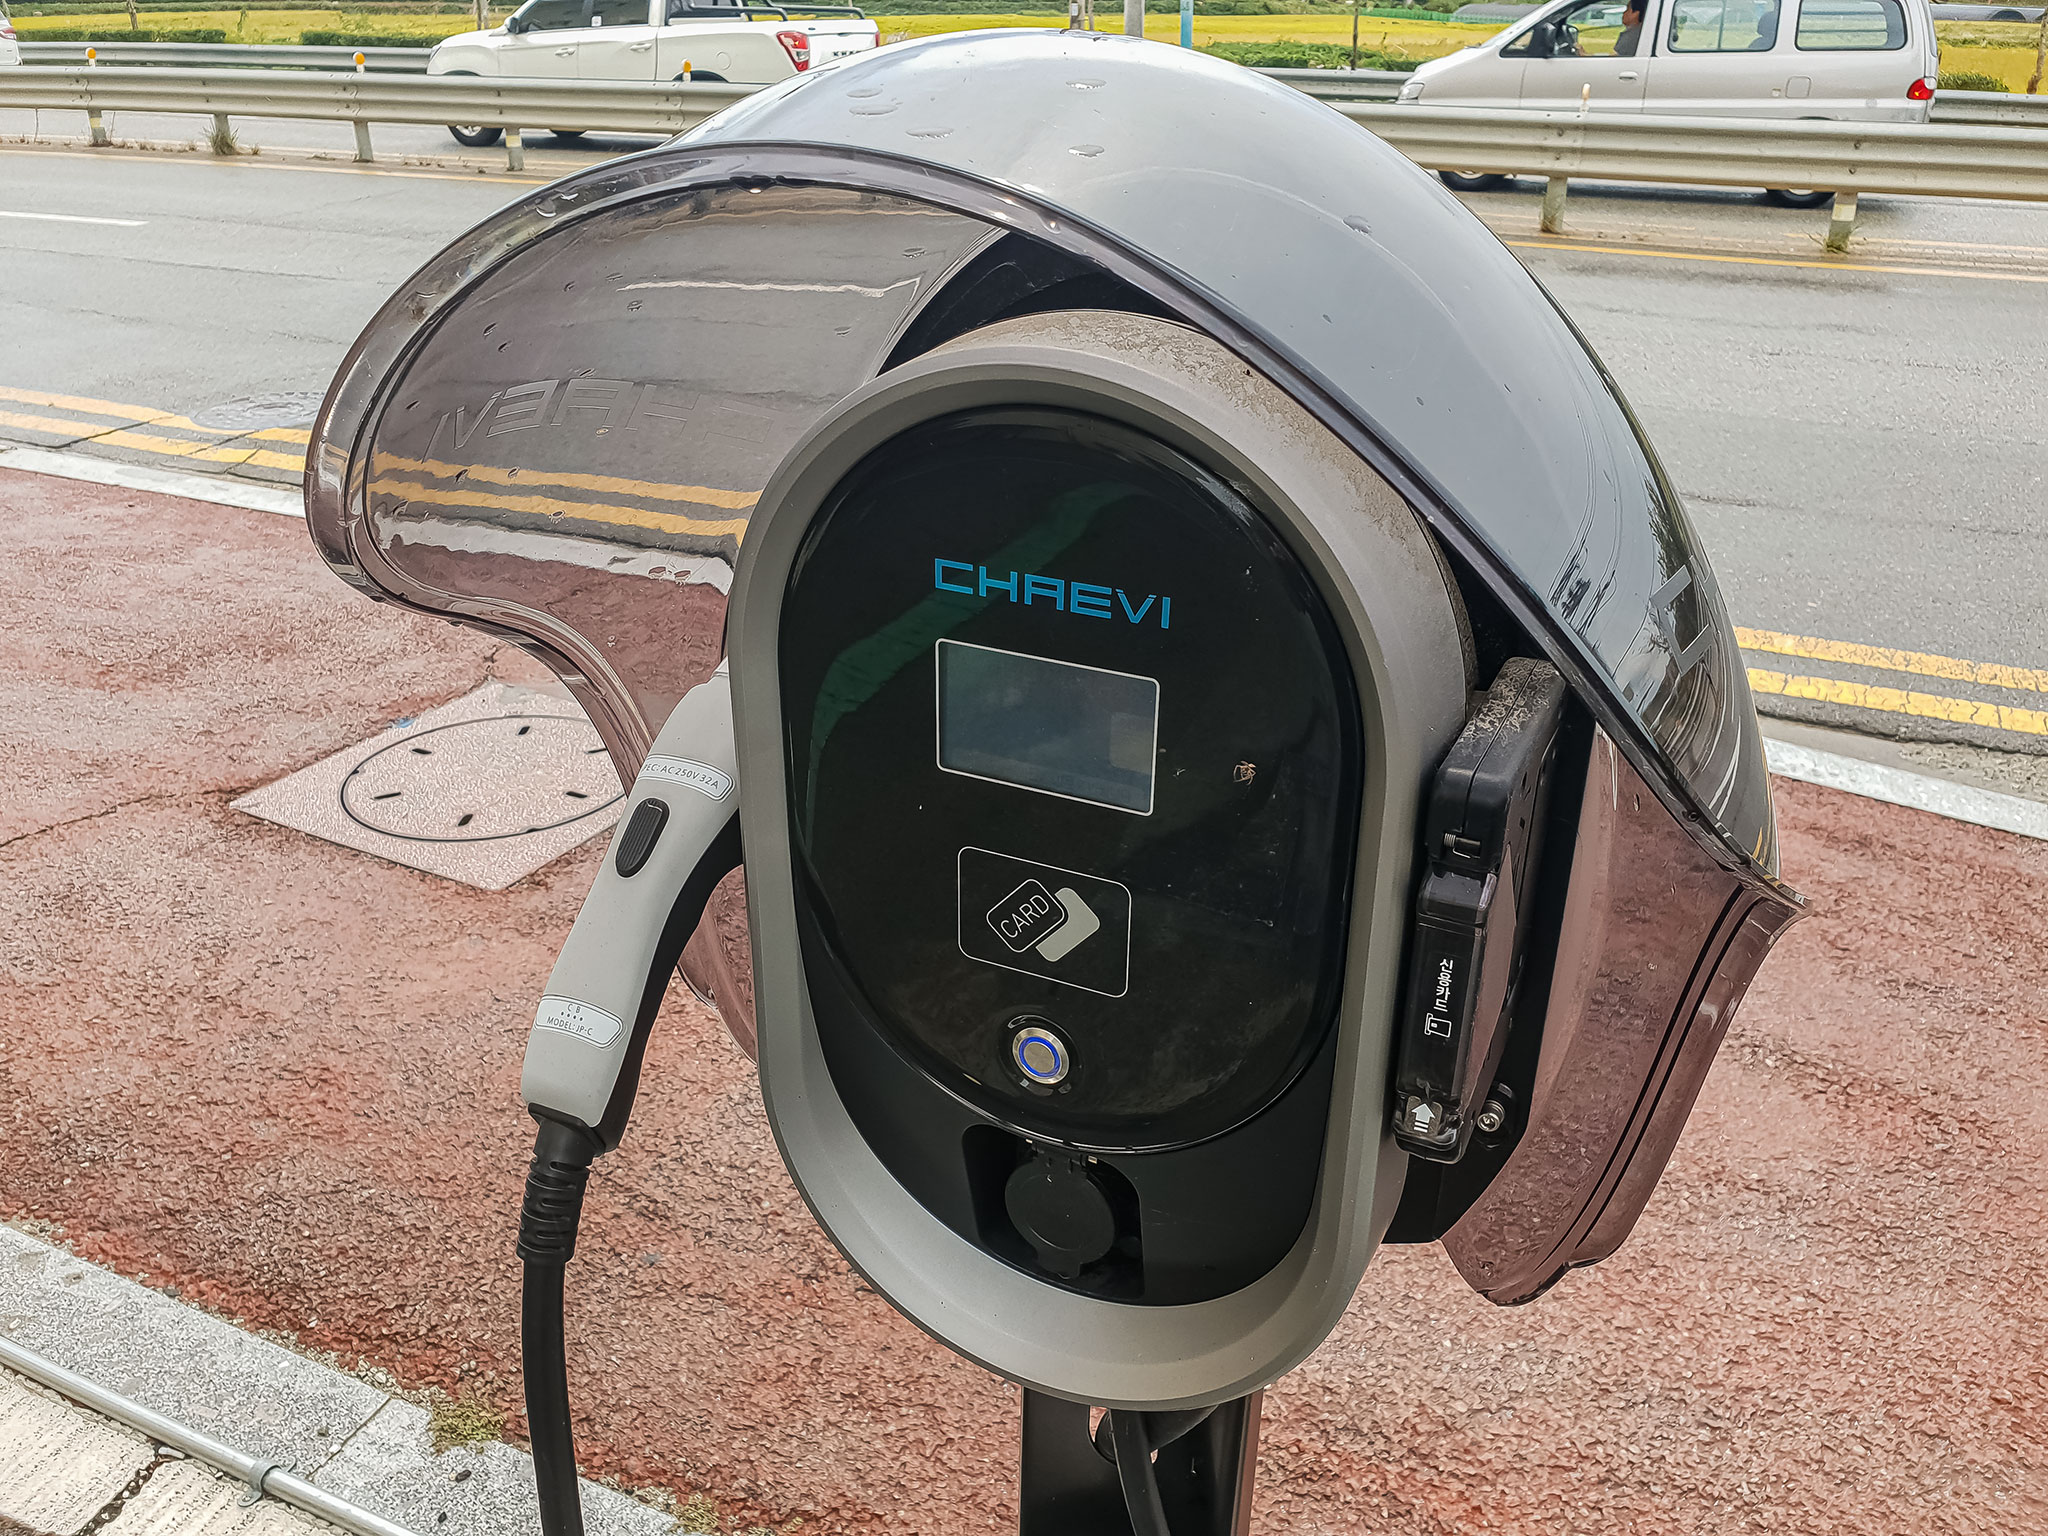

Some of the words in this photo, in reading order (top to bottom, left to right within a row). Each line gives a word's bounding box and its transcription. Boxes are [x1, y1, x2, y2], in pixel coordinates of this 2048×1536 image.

[934, 558, 1171, 629] CHAEVI
[660, 765, 674, 774] AC
[675, 768, 699, 780] 250V
[699, 774, 720, 789] 32A
[1000, 894, 1050, 938] CARD
[1433, 958, 1454, 1013] 신용카드
